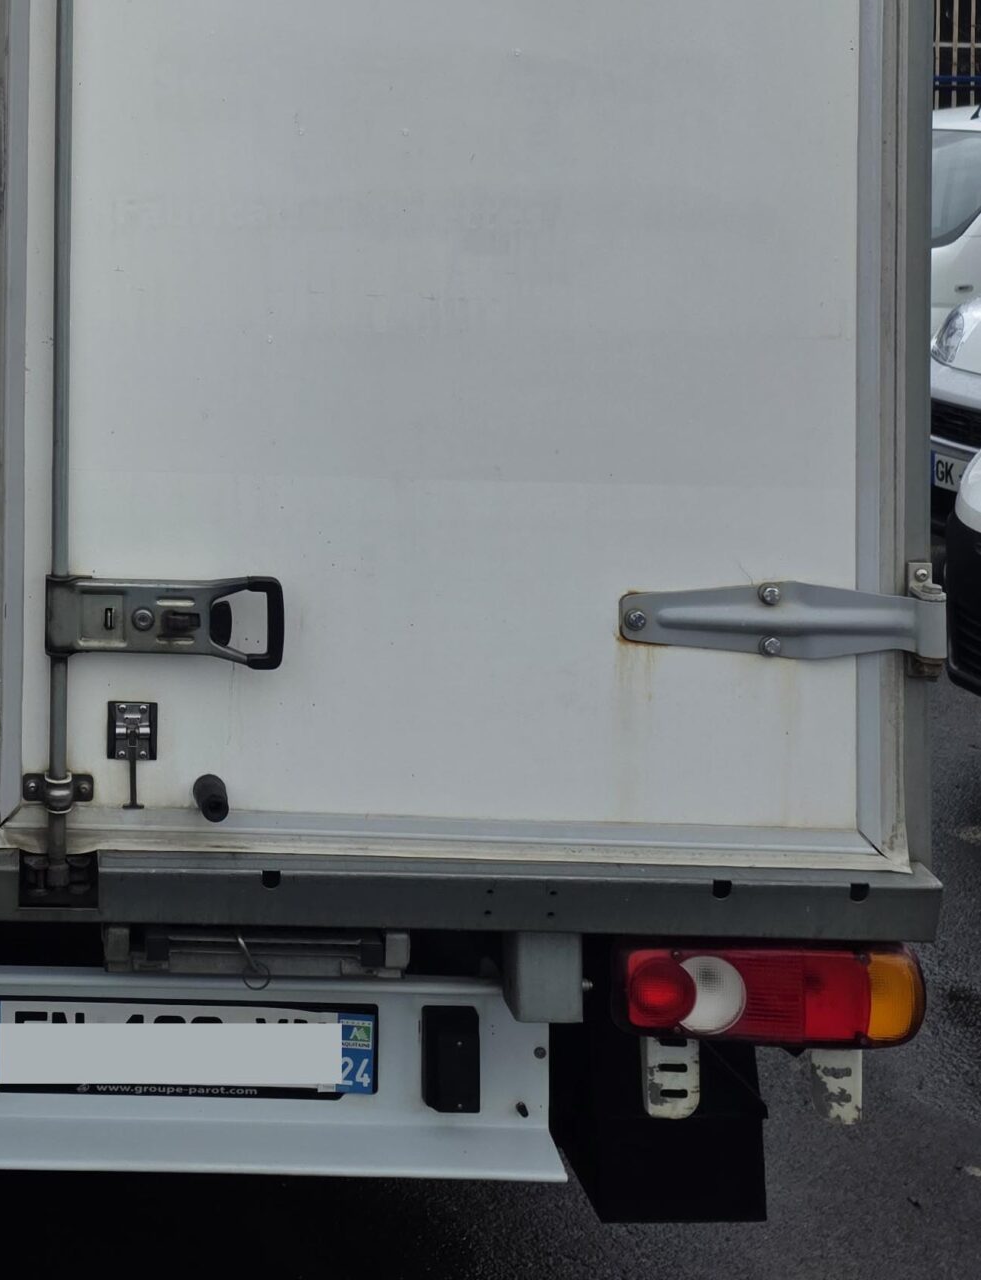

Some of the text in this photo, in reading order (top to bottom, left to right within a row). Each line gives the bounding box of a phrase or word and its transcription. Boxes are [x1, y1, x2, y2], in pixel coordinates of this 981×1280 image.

[935, 459, 954, 485] GK
[342, 1056, 371, 1088] 24
[96, 1082, 258, 1096] www.groupe-parot.com
